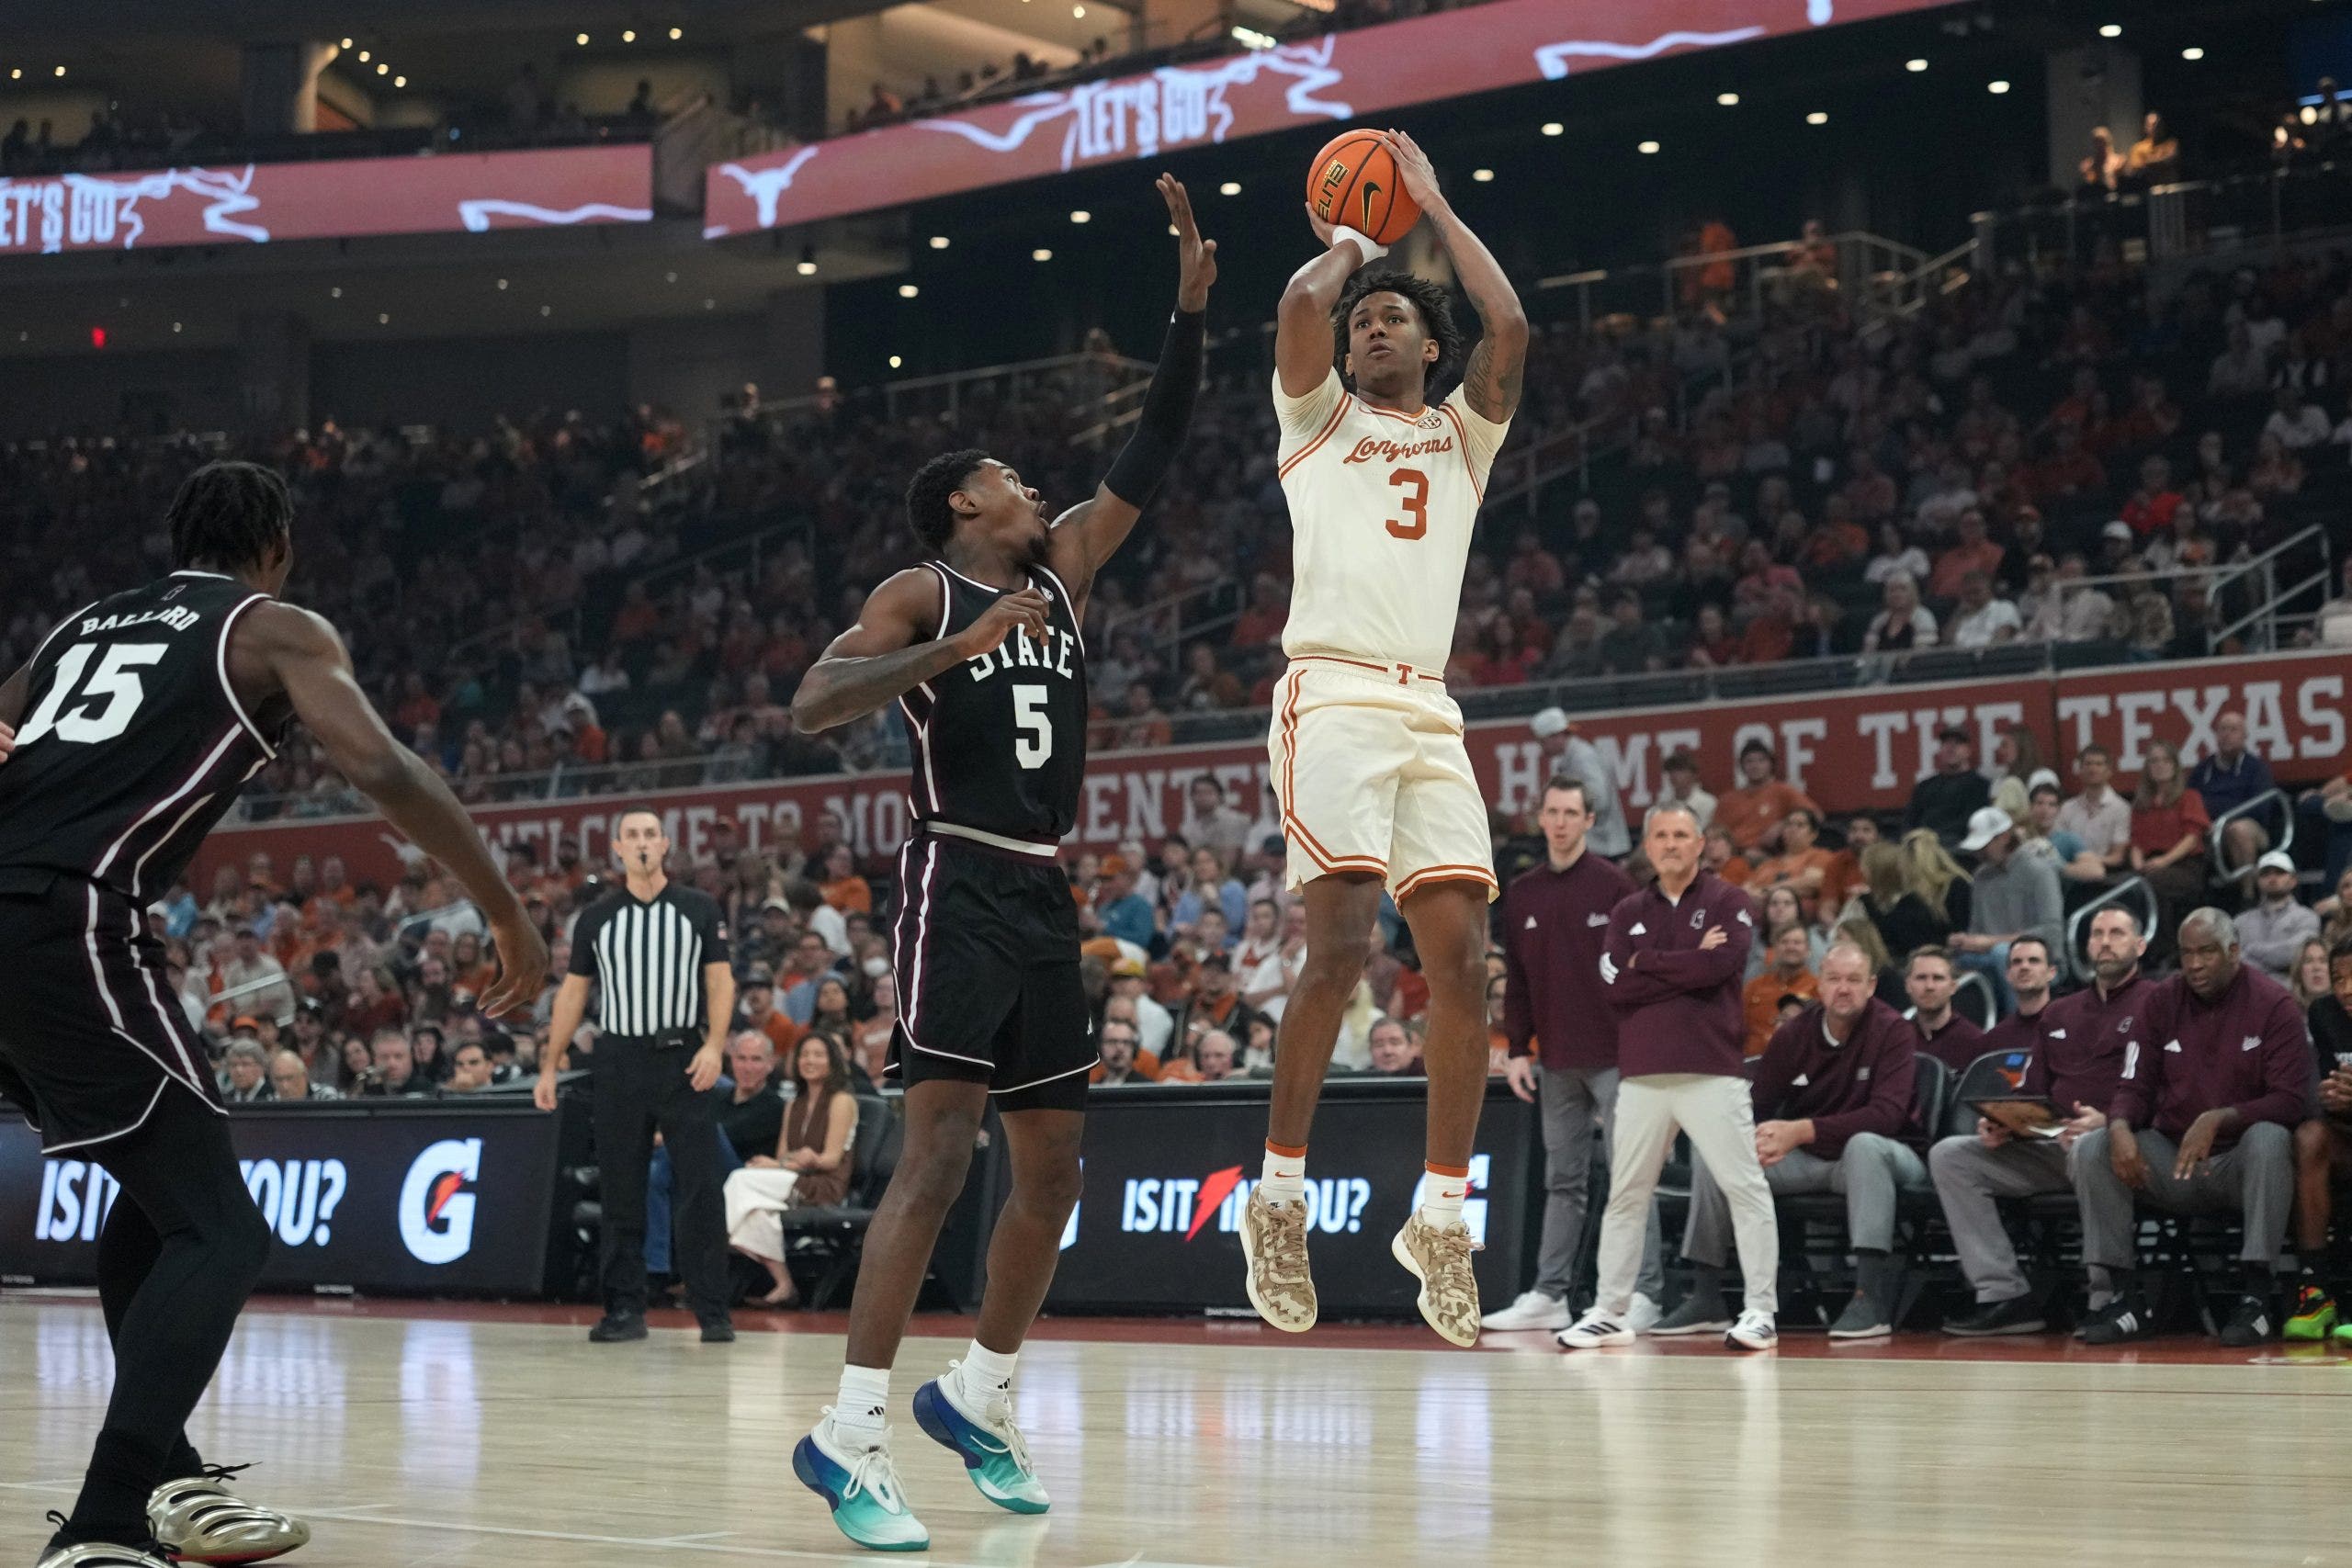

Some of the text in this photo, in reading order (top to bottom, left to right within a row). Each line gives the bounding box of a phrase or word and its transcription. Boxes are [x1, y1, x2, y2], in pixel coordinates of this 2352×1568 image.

[1079, 83, 1159, 157] LET'S
[0, 184, 63, 250] ET'S
[1343, 435, 1453, 464] Longhorns
[1385, 468, 1430, 540] 3
[14, 643, 169, 745] 15
[1396, 663, 1412, 685] T
[1012, 684, 1053, 770] 5
[1495, 729, 1702, 816] HME
[2058, 676, 2346, 773] TEXAS
[239, 1158, 346, 1247] OU?
[398, 1138, 482, 1264] G
[1305, 1178, 1370, 1233] OU?
